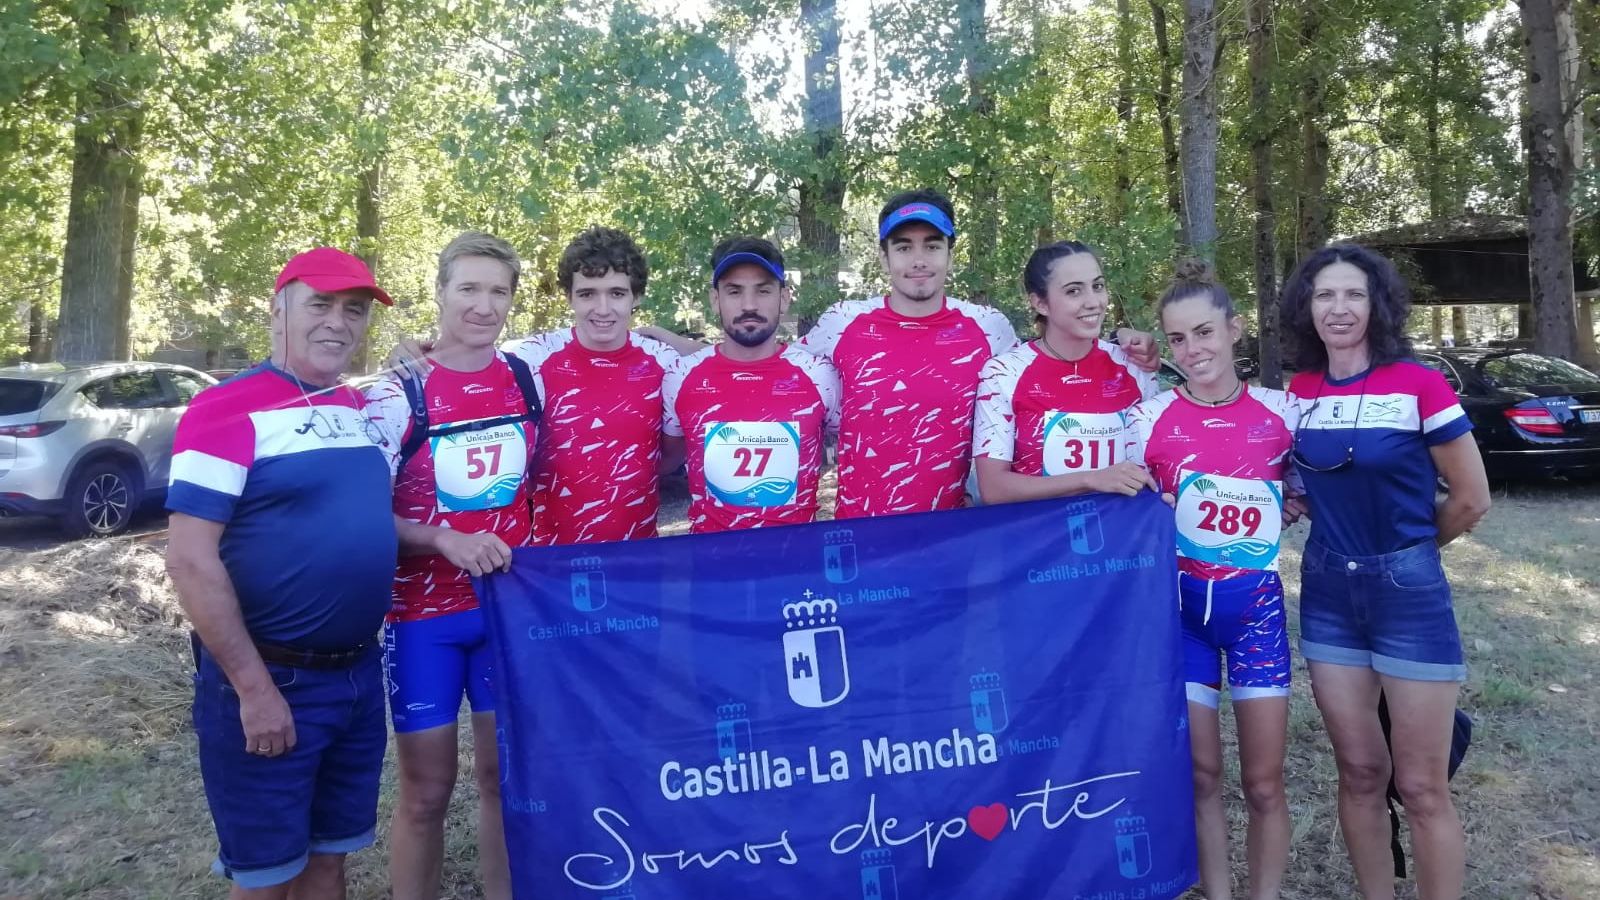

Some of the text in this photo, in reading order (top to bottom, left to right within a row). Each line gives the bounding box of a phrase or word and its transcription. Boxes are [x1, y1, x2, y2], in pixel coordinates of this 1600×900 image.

[466, 431, 516, 442] Unicaja Banco
[738, 435, 789, 444] Unicaja Banco
[1080, 427, 1108, 437] Unicaja
[466, 444, 502, 480] 57
[733, 447, 773, 477] 27
[1064, 439, 1116, 469] 311
[1216, 490, 1272, 503] Unicaja Banco
[1196, 500, 1262, 537] 289
[1027, 554, 1155, 584] Castilla-La Mancha
[858, 586, 910, 603] Mancha
[528, 615, 659, 640] Castilla-La Mancha
[1009, 735, 1060, 756] Mancha
[660, 728, 998, 801] Castilla-La Mancha
[564, 807, 799, 891] Somos
